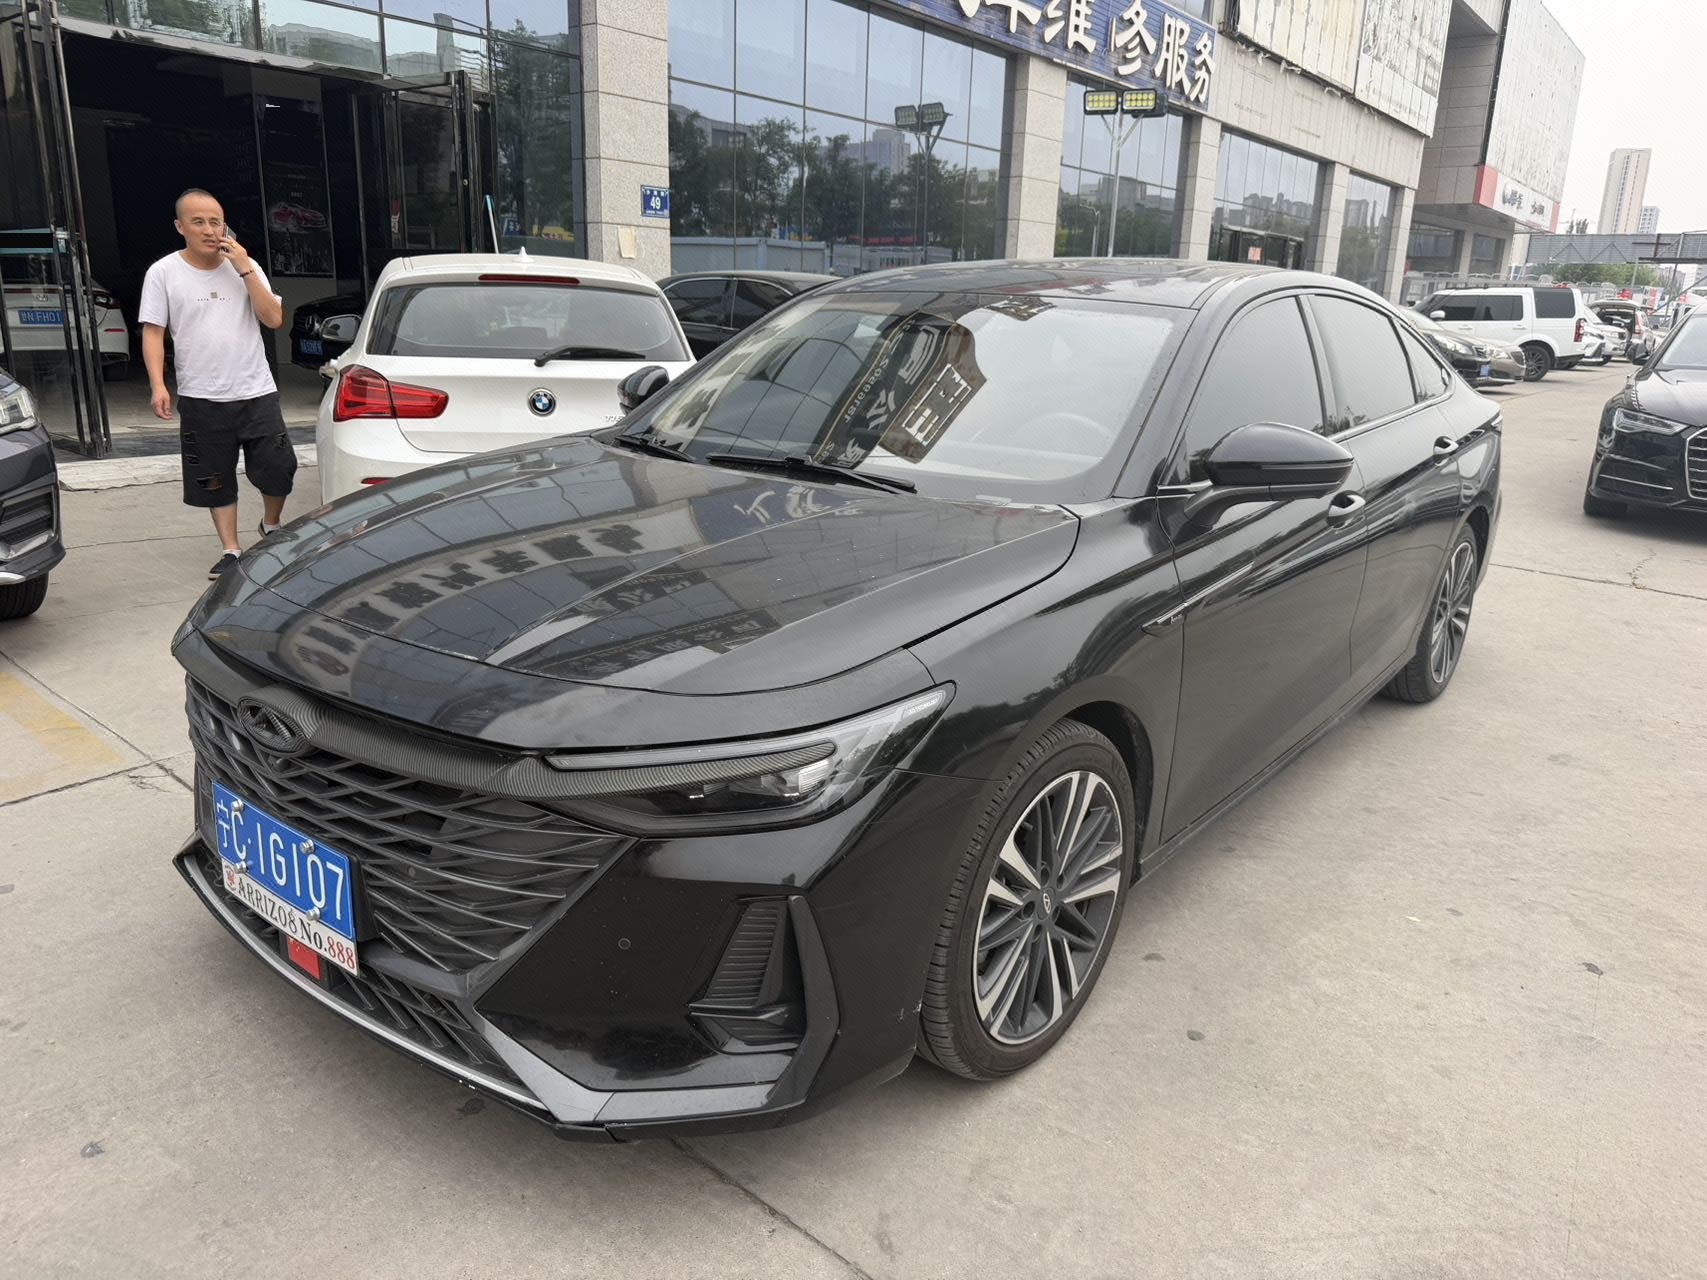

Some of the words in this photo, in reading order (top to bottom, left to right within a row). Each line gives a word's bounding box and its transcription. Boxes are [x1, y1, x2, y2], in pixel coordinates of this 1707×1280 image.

[958, 0, 1217, 103] 维修服务
[650, 196, 661, 210] 49
[299, 917, 356, 970] No.888
